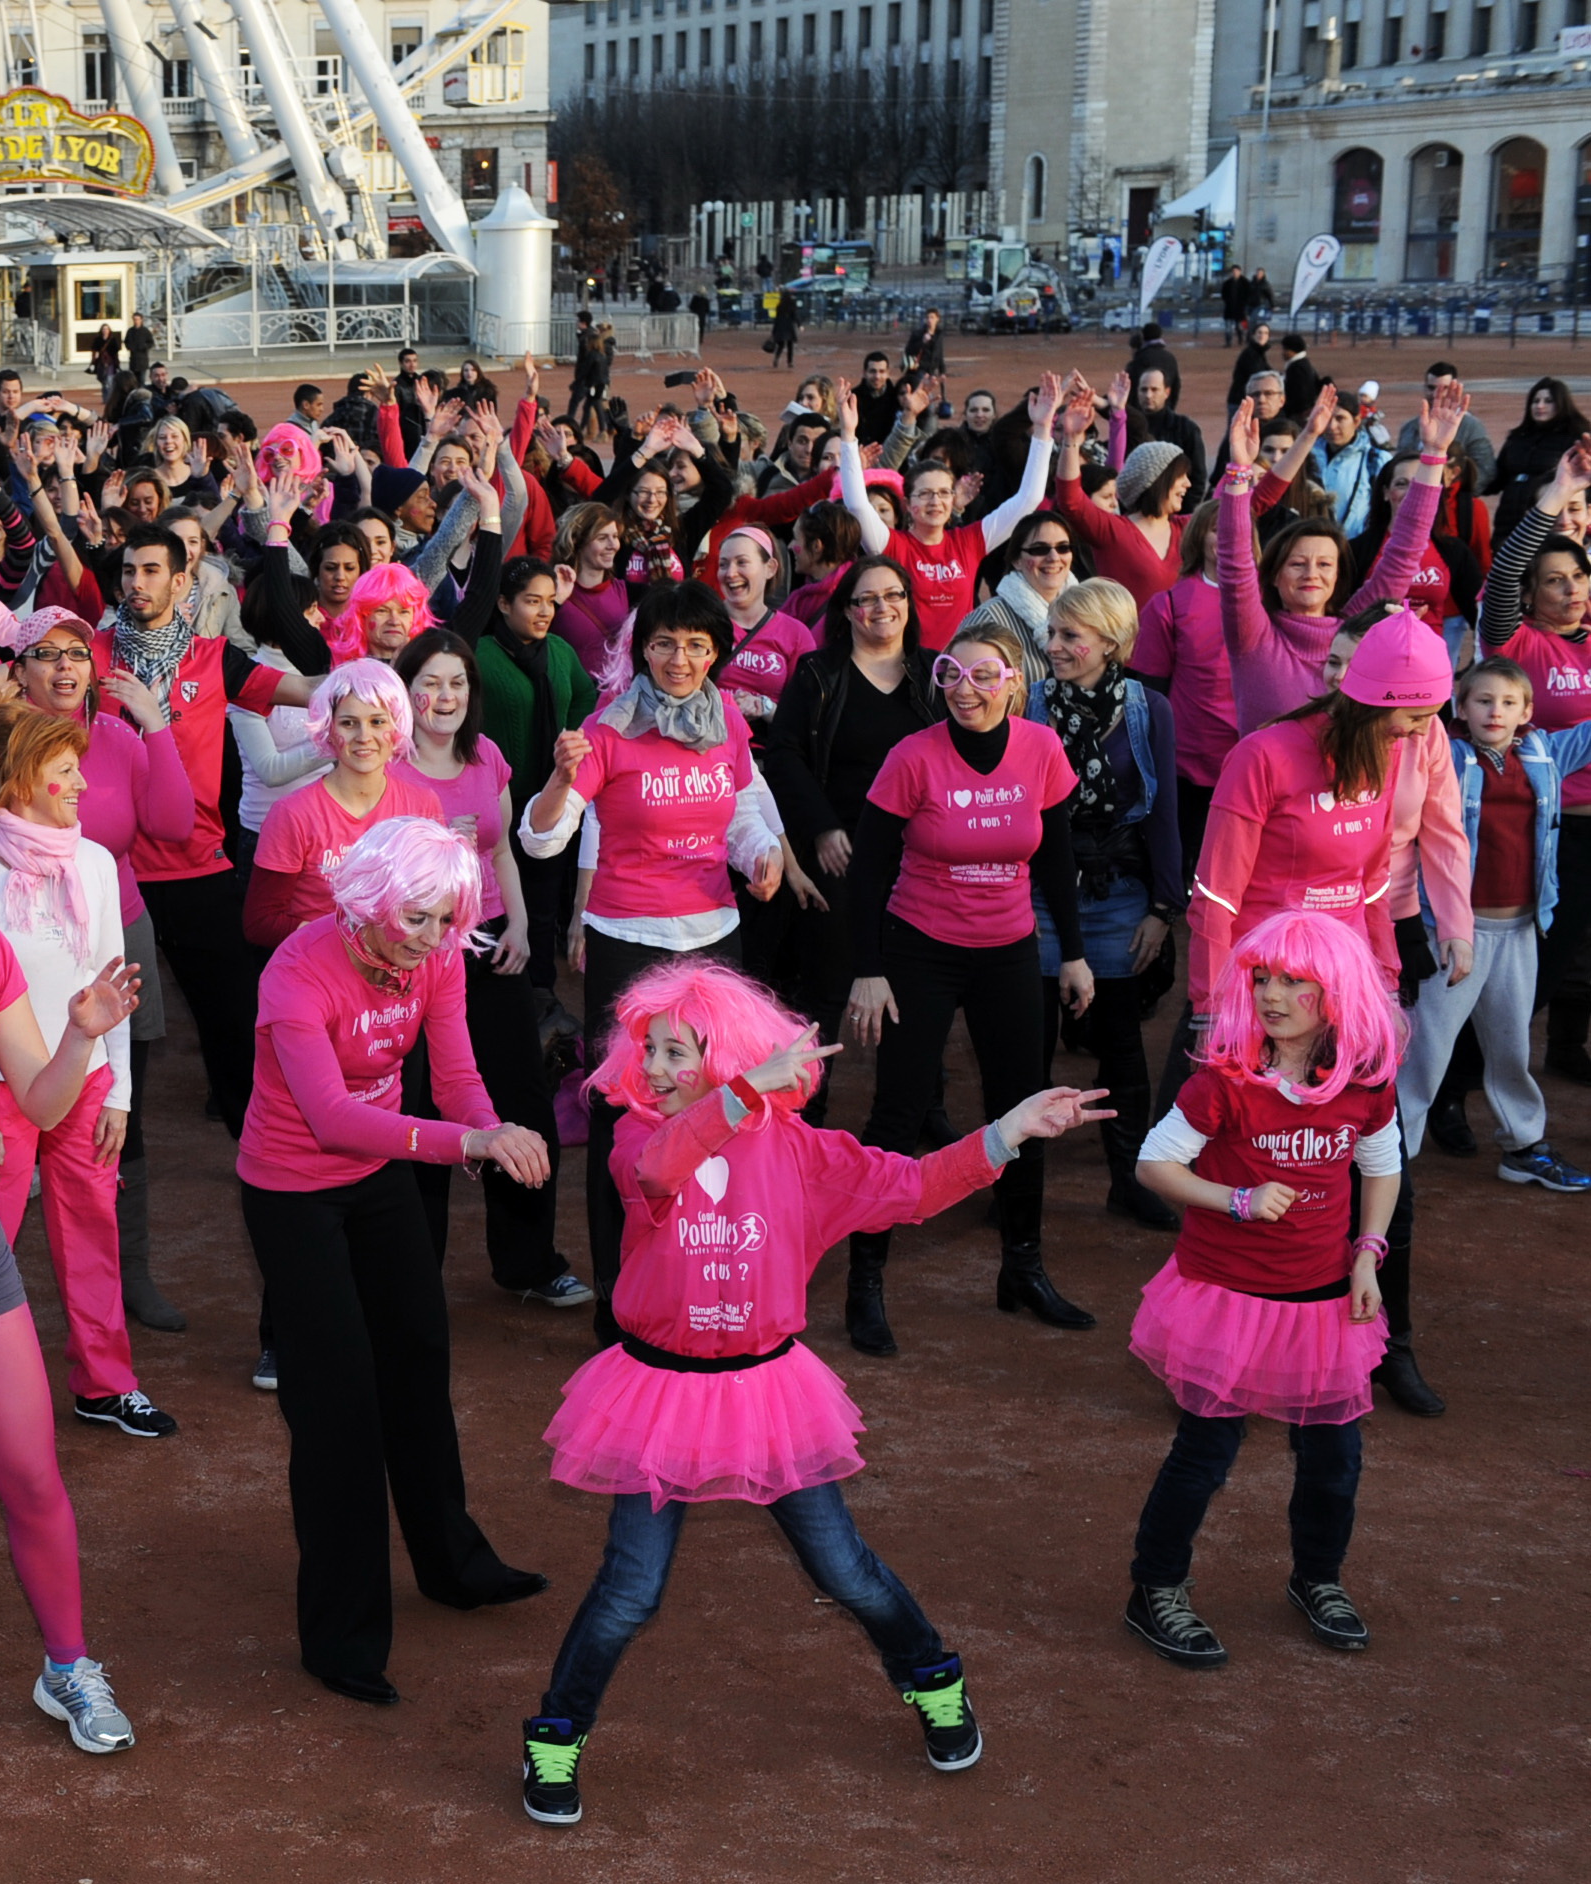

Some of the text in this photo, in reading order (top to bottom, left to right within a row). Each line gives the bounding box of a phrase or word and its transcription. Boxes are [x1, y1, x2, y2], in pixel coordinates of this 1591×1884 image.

[13, 103, 49, 127] LA
[4, 135, 43, 160] DE
[736, 650, 765, 669] elles
[1547, 666, 1581, 690] Pour
[642, 766, 716, 799] Pour elles
[975, 790, 995, 805] Pour
[996, 787, 1013, 802] elles
[1311, 793, 1316, 815] I
[967, 814, 1011, 830] et vous ?
[1333, 816, 1372, 836] et vous ?
[397, 1033, 405, 1047] ?
[1272, 1127, 1331, 1161] Pour Elles
[703, 1260, 716, 1281] et
[738, 1262, 749, 1281] ?
